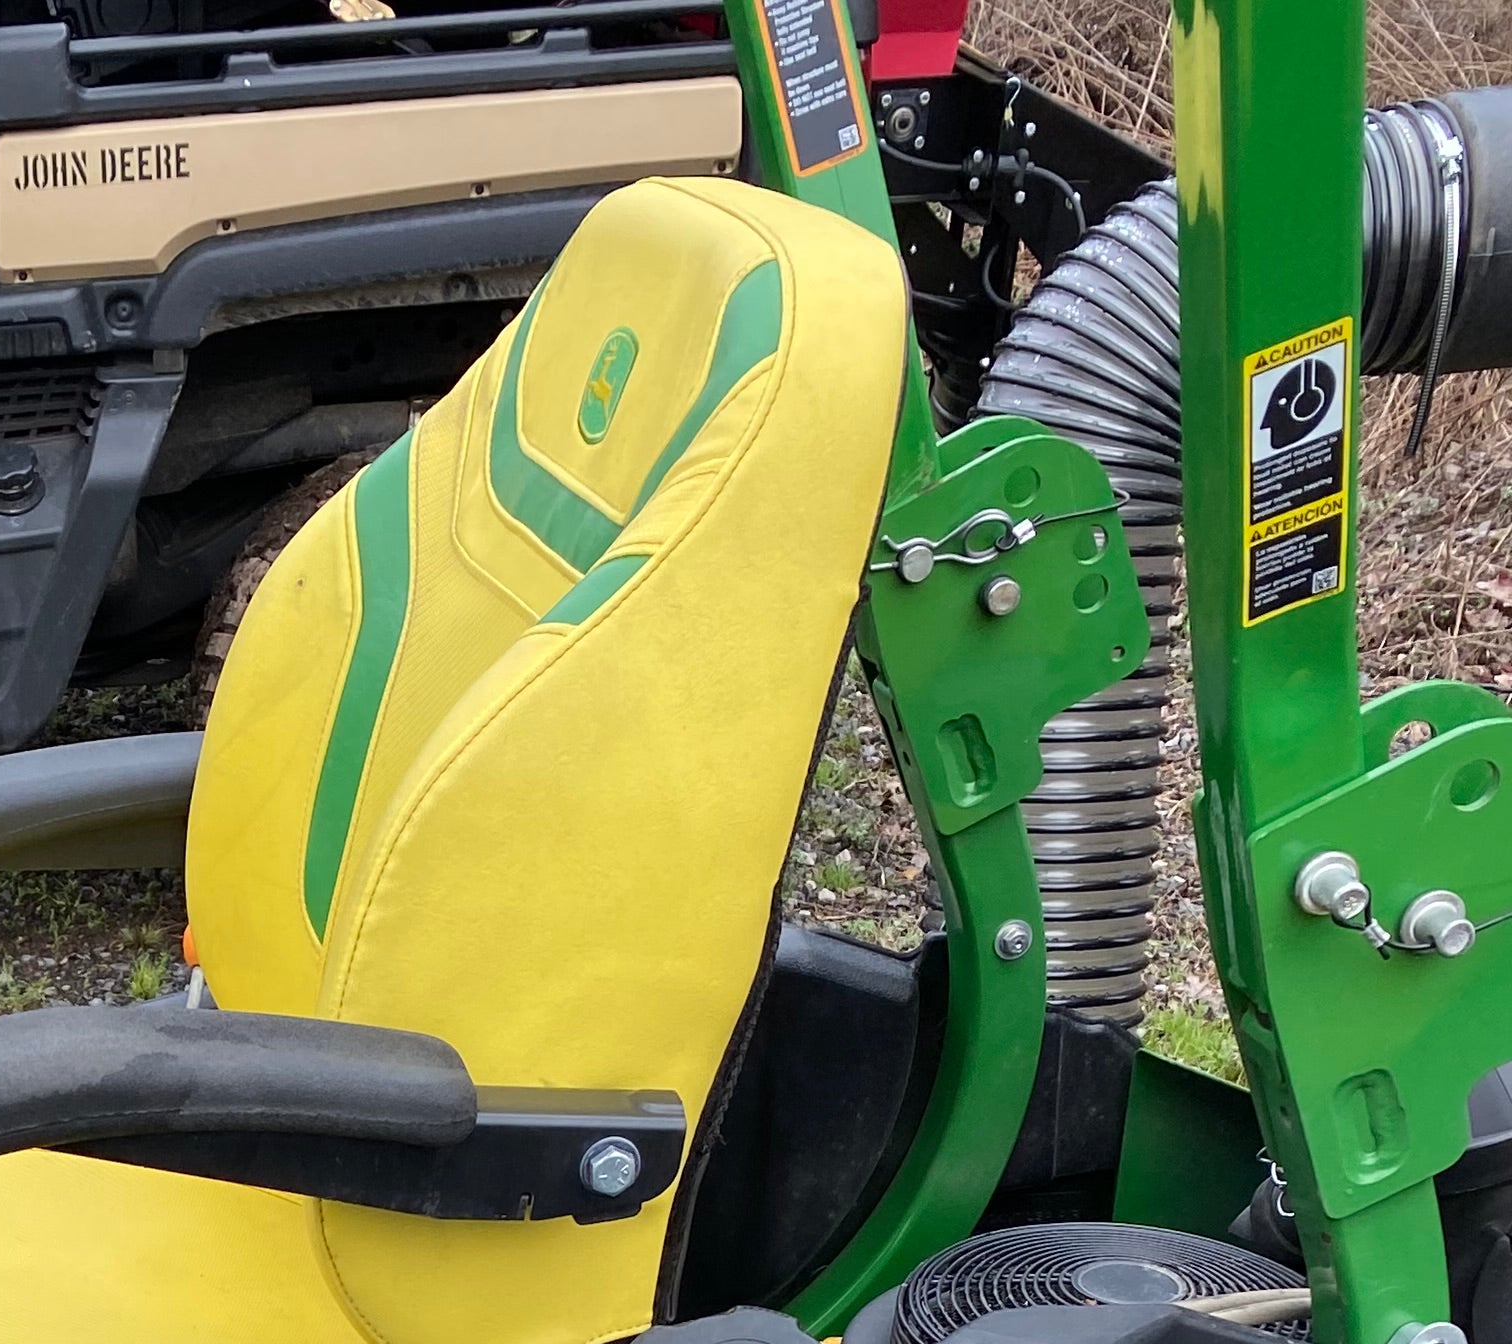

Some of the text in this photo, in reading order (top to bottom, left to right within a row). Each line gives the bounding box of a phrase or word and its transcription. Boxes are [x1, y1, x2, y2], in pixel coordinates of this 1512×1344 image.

[12, 142, 192, 191] JOHN DEERE
[1268, 324, 1344, 365] CAUTION
[1264, 498, 1344, 538] ATENCIÓN
